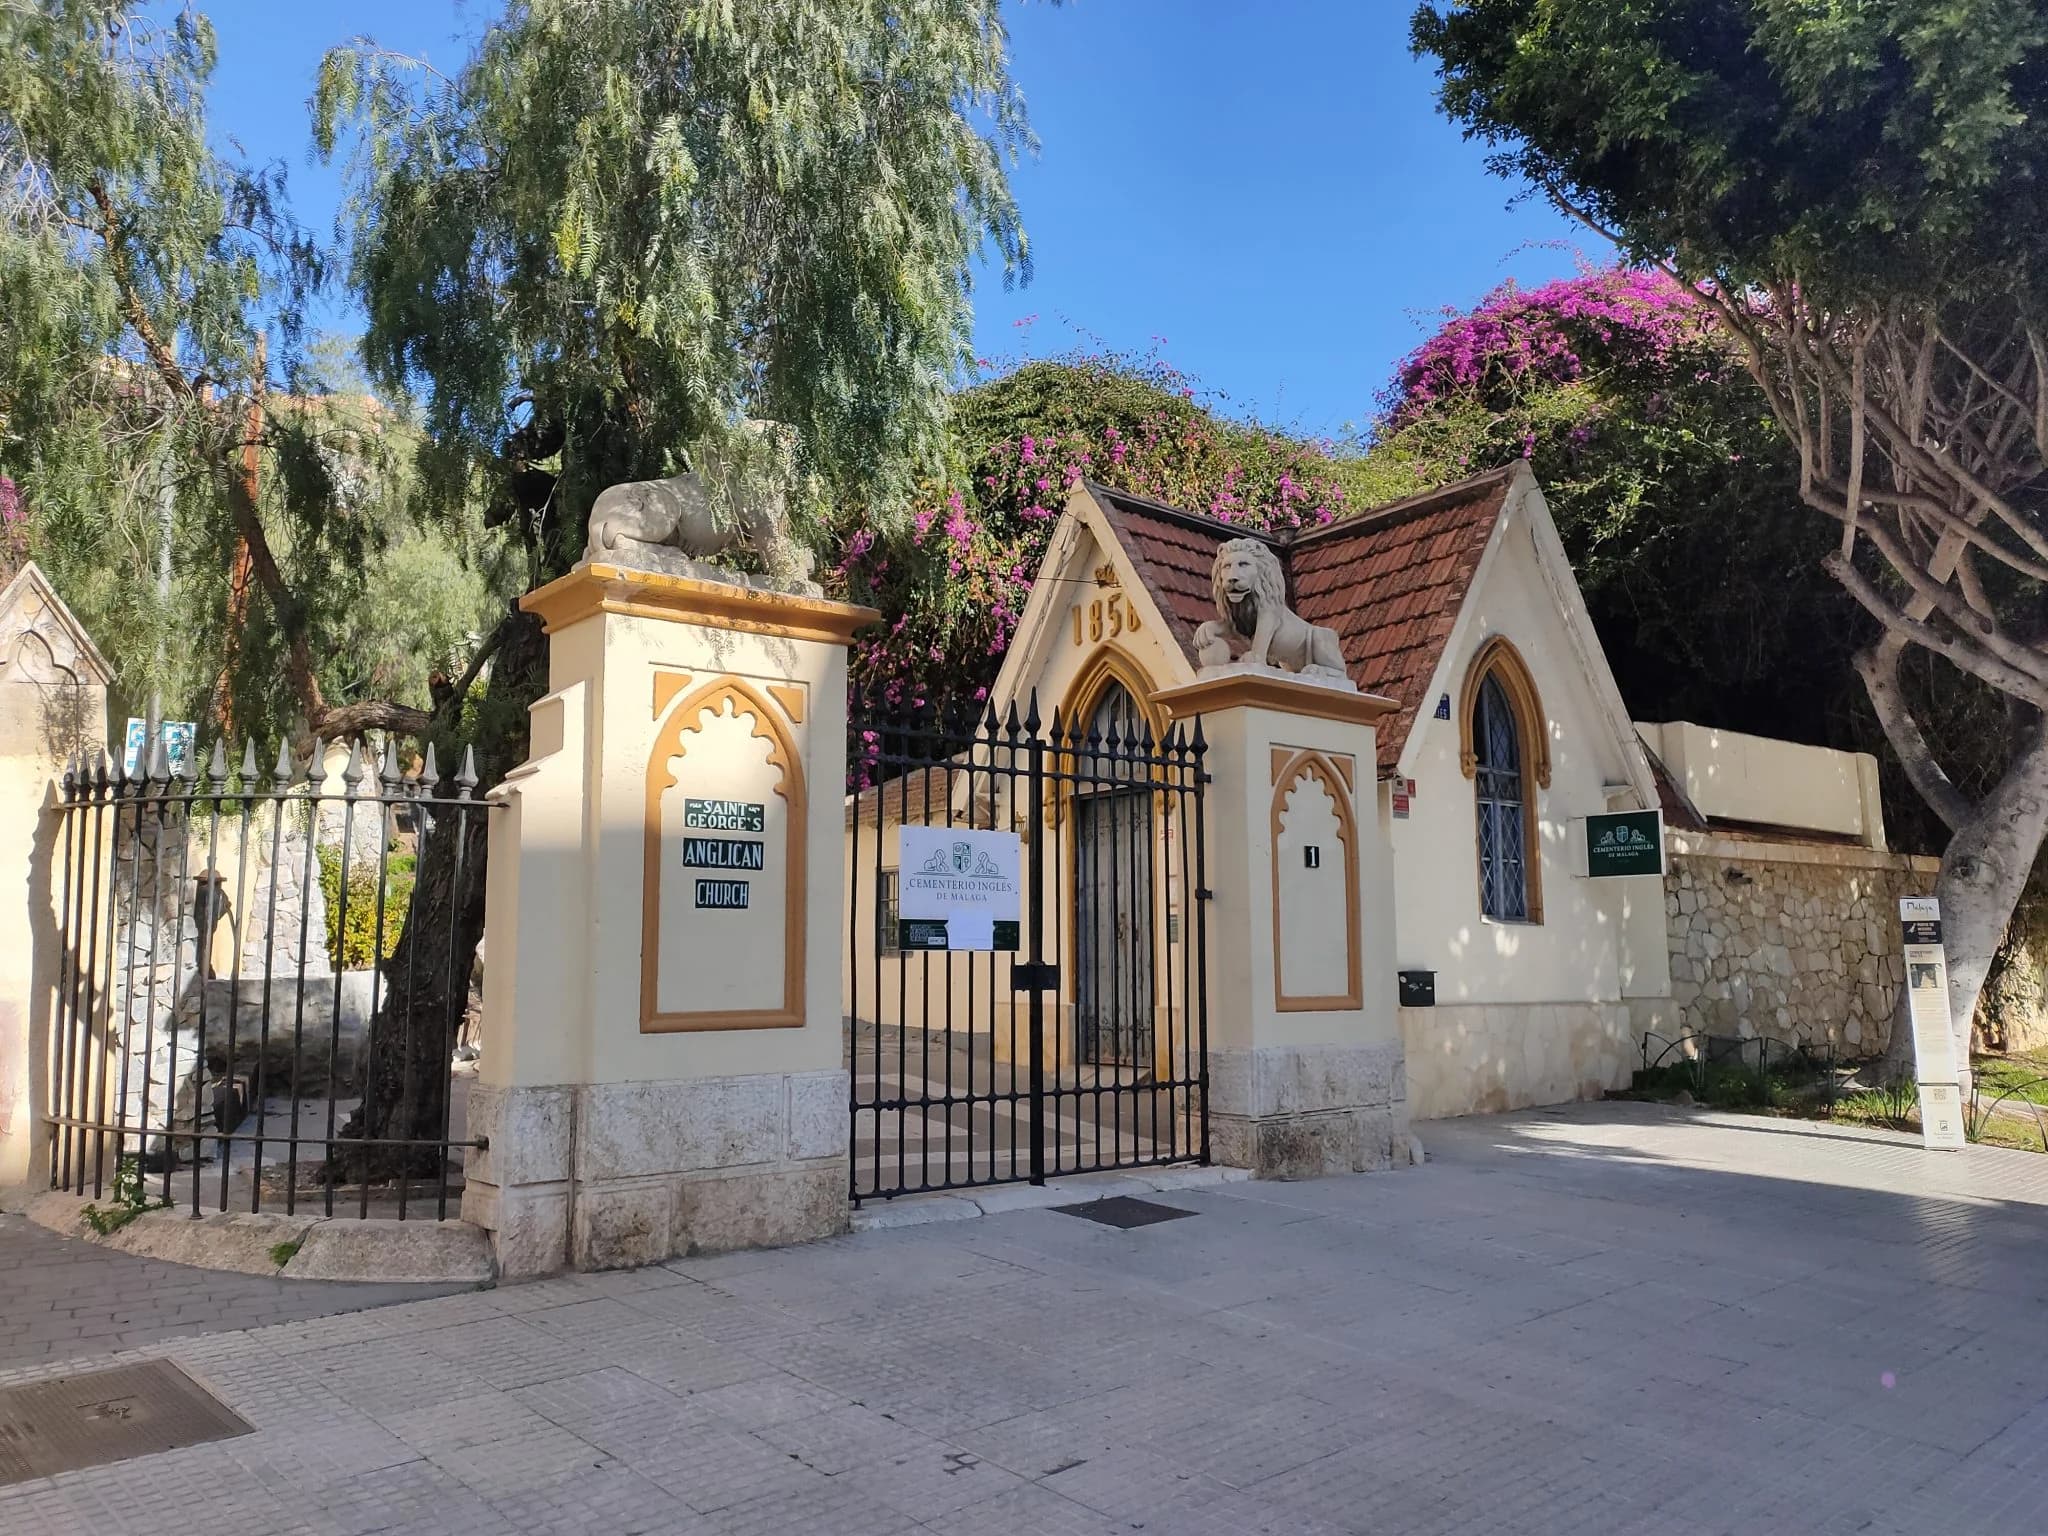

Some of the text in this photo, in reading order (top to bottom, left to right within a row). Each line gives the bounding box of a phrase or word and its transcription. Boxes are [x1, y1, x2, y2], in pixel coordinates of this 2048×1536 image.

[703, 800, 747, 816] SAINT
[686, 813, 762, 831] GEORGE'S
[684, 840, 762, 868] ANGLICAN
[1309, 846, 1317, 867] 1
[909, 878, 976, 891] CEMENTERIO
[697, 882, 748, 906] CHURCH
[936, 892, 948, 900] DE
